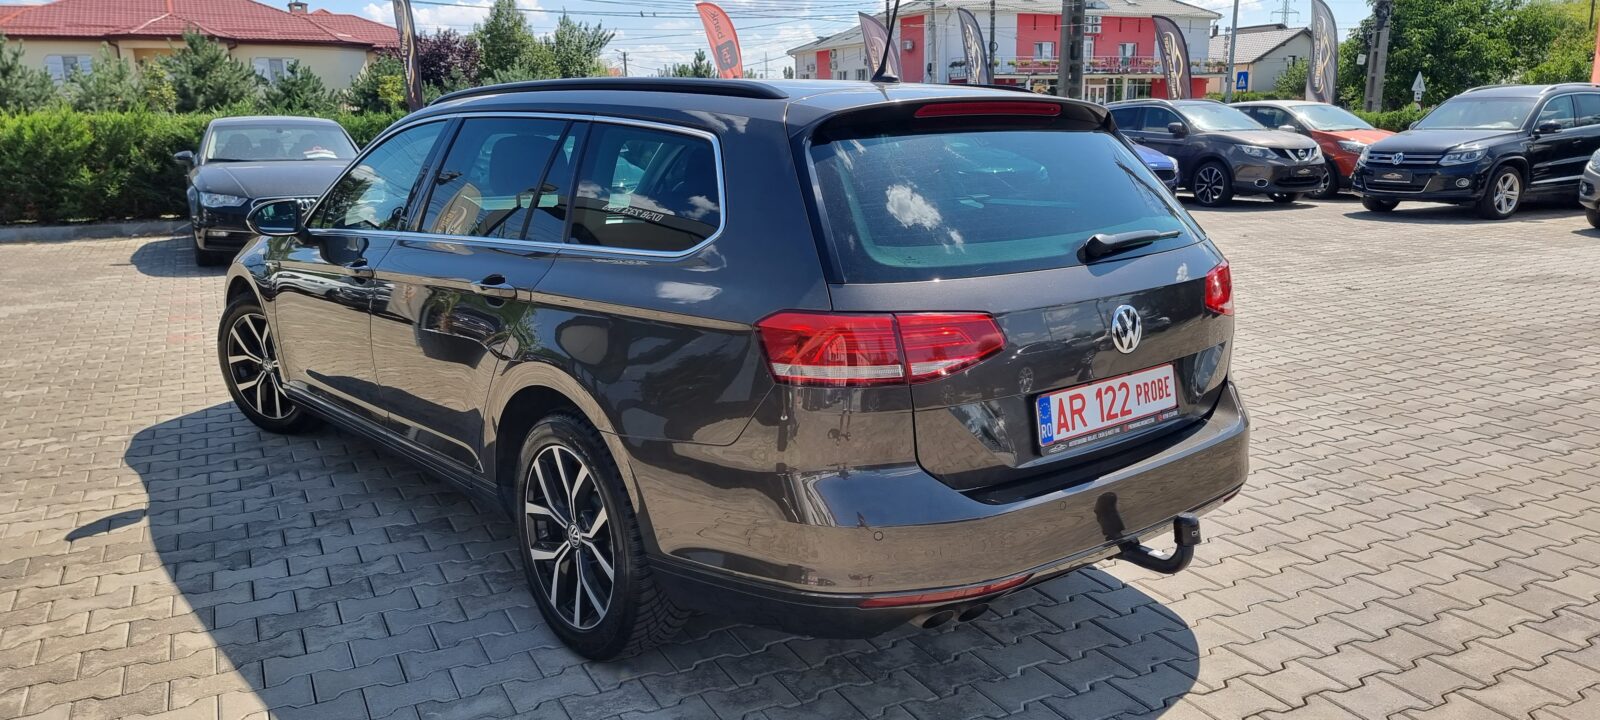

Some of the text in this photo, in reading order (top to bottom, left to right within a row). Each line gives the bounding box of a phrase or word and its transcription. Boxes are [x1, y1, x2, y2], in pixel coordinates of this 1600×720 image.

[1056, 376, 1172, 435] AR 122 PROBE
[1041, 422, 1053, 439] RO
